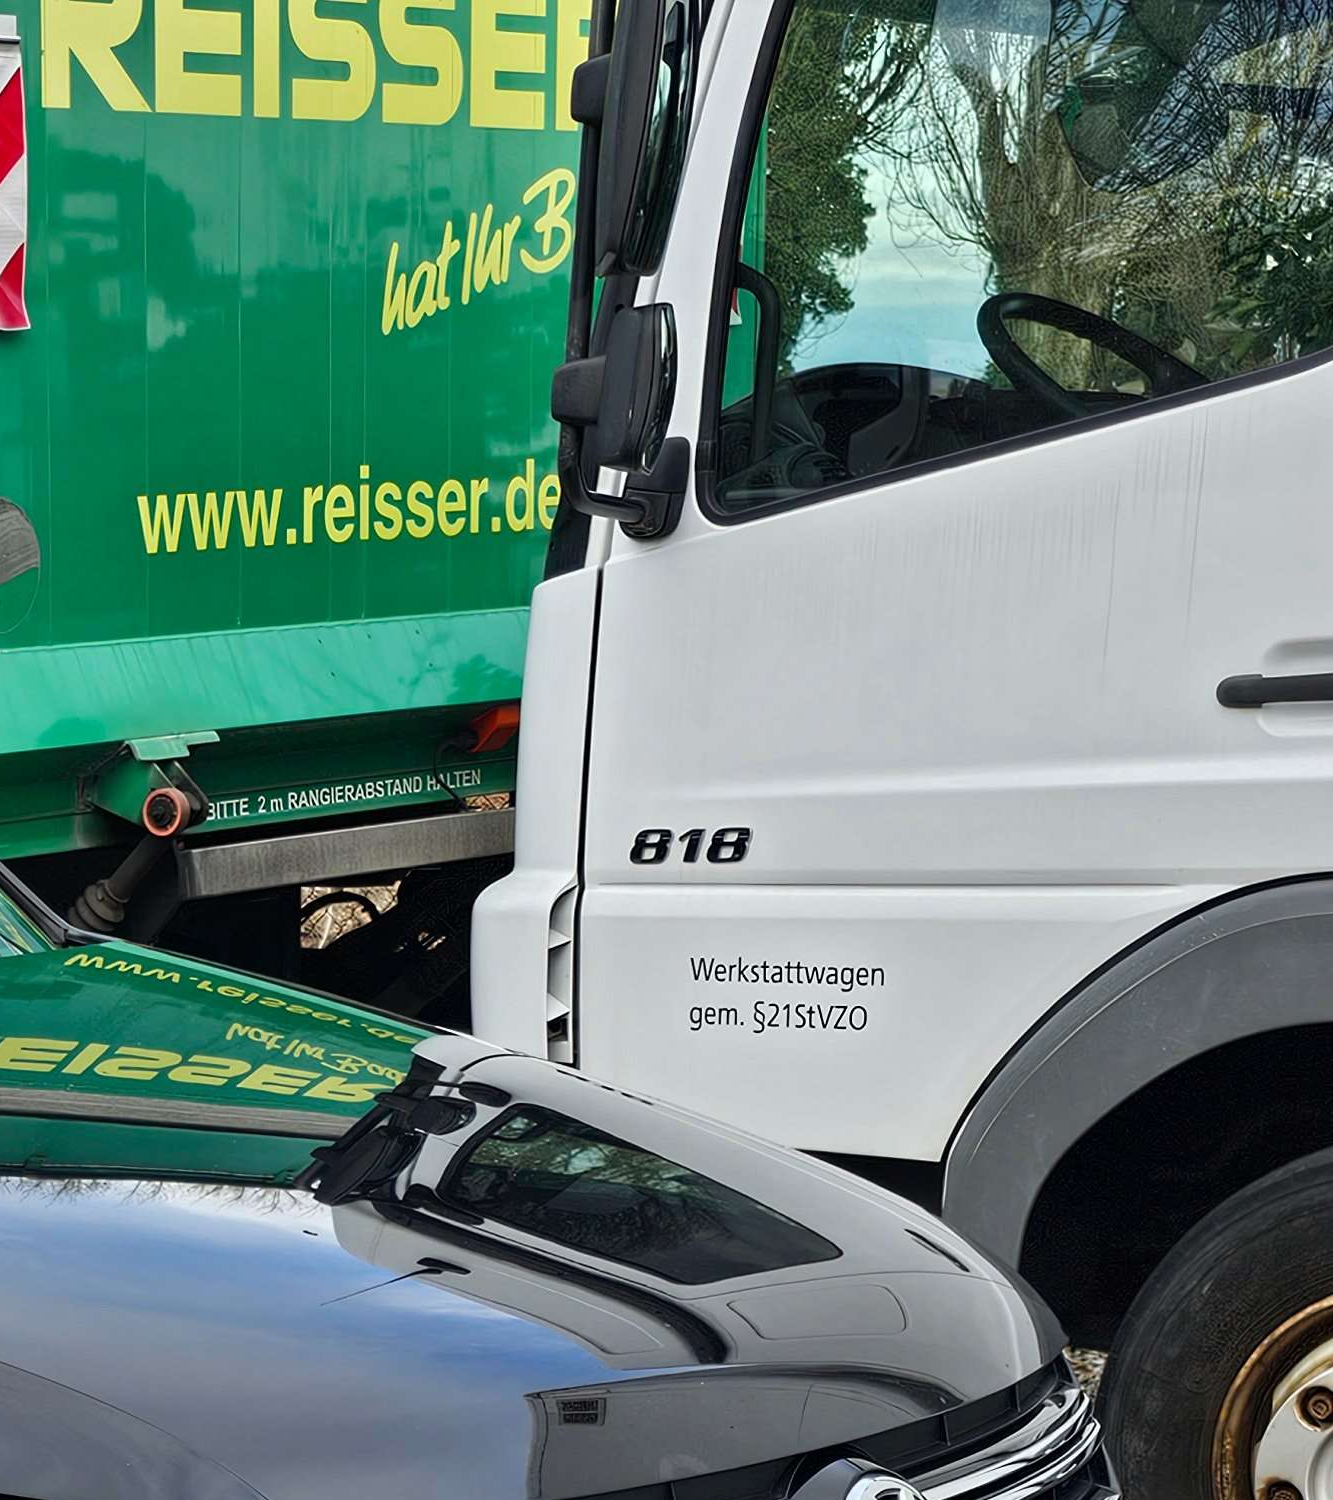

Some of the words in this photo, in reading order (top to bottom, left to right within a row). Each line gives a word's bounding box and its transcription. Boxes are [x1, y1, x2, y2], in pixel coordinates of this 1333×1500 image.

[382, 242, 460, 335] hat
[461, 203, 521, 305] Ihr
[137, 458, 561, 555] www.reisser.de
[207, 797, 250, 821] BITTE
[257, 796, 267, 814] 2
[270, 797, 284, 813] m
[288, 776, 423, 810] RANGIERABSTAND
[629, 827, 753, 865] 818
[690, 957, 885, 992] Werkstattwagen
[689, 1005, 745, 1031] gem.
[752, 1001, 869, 1034] §21StVZO
